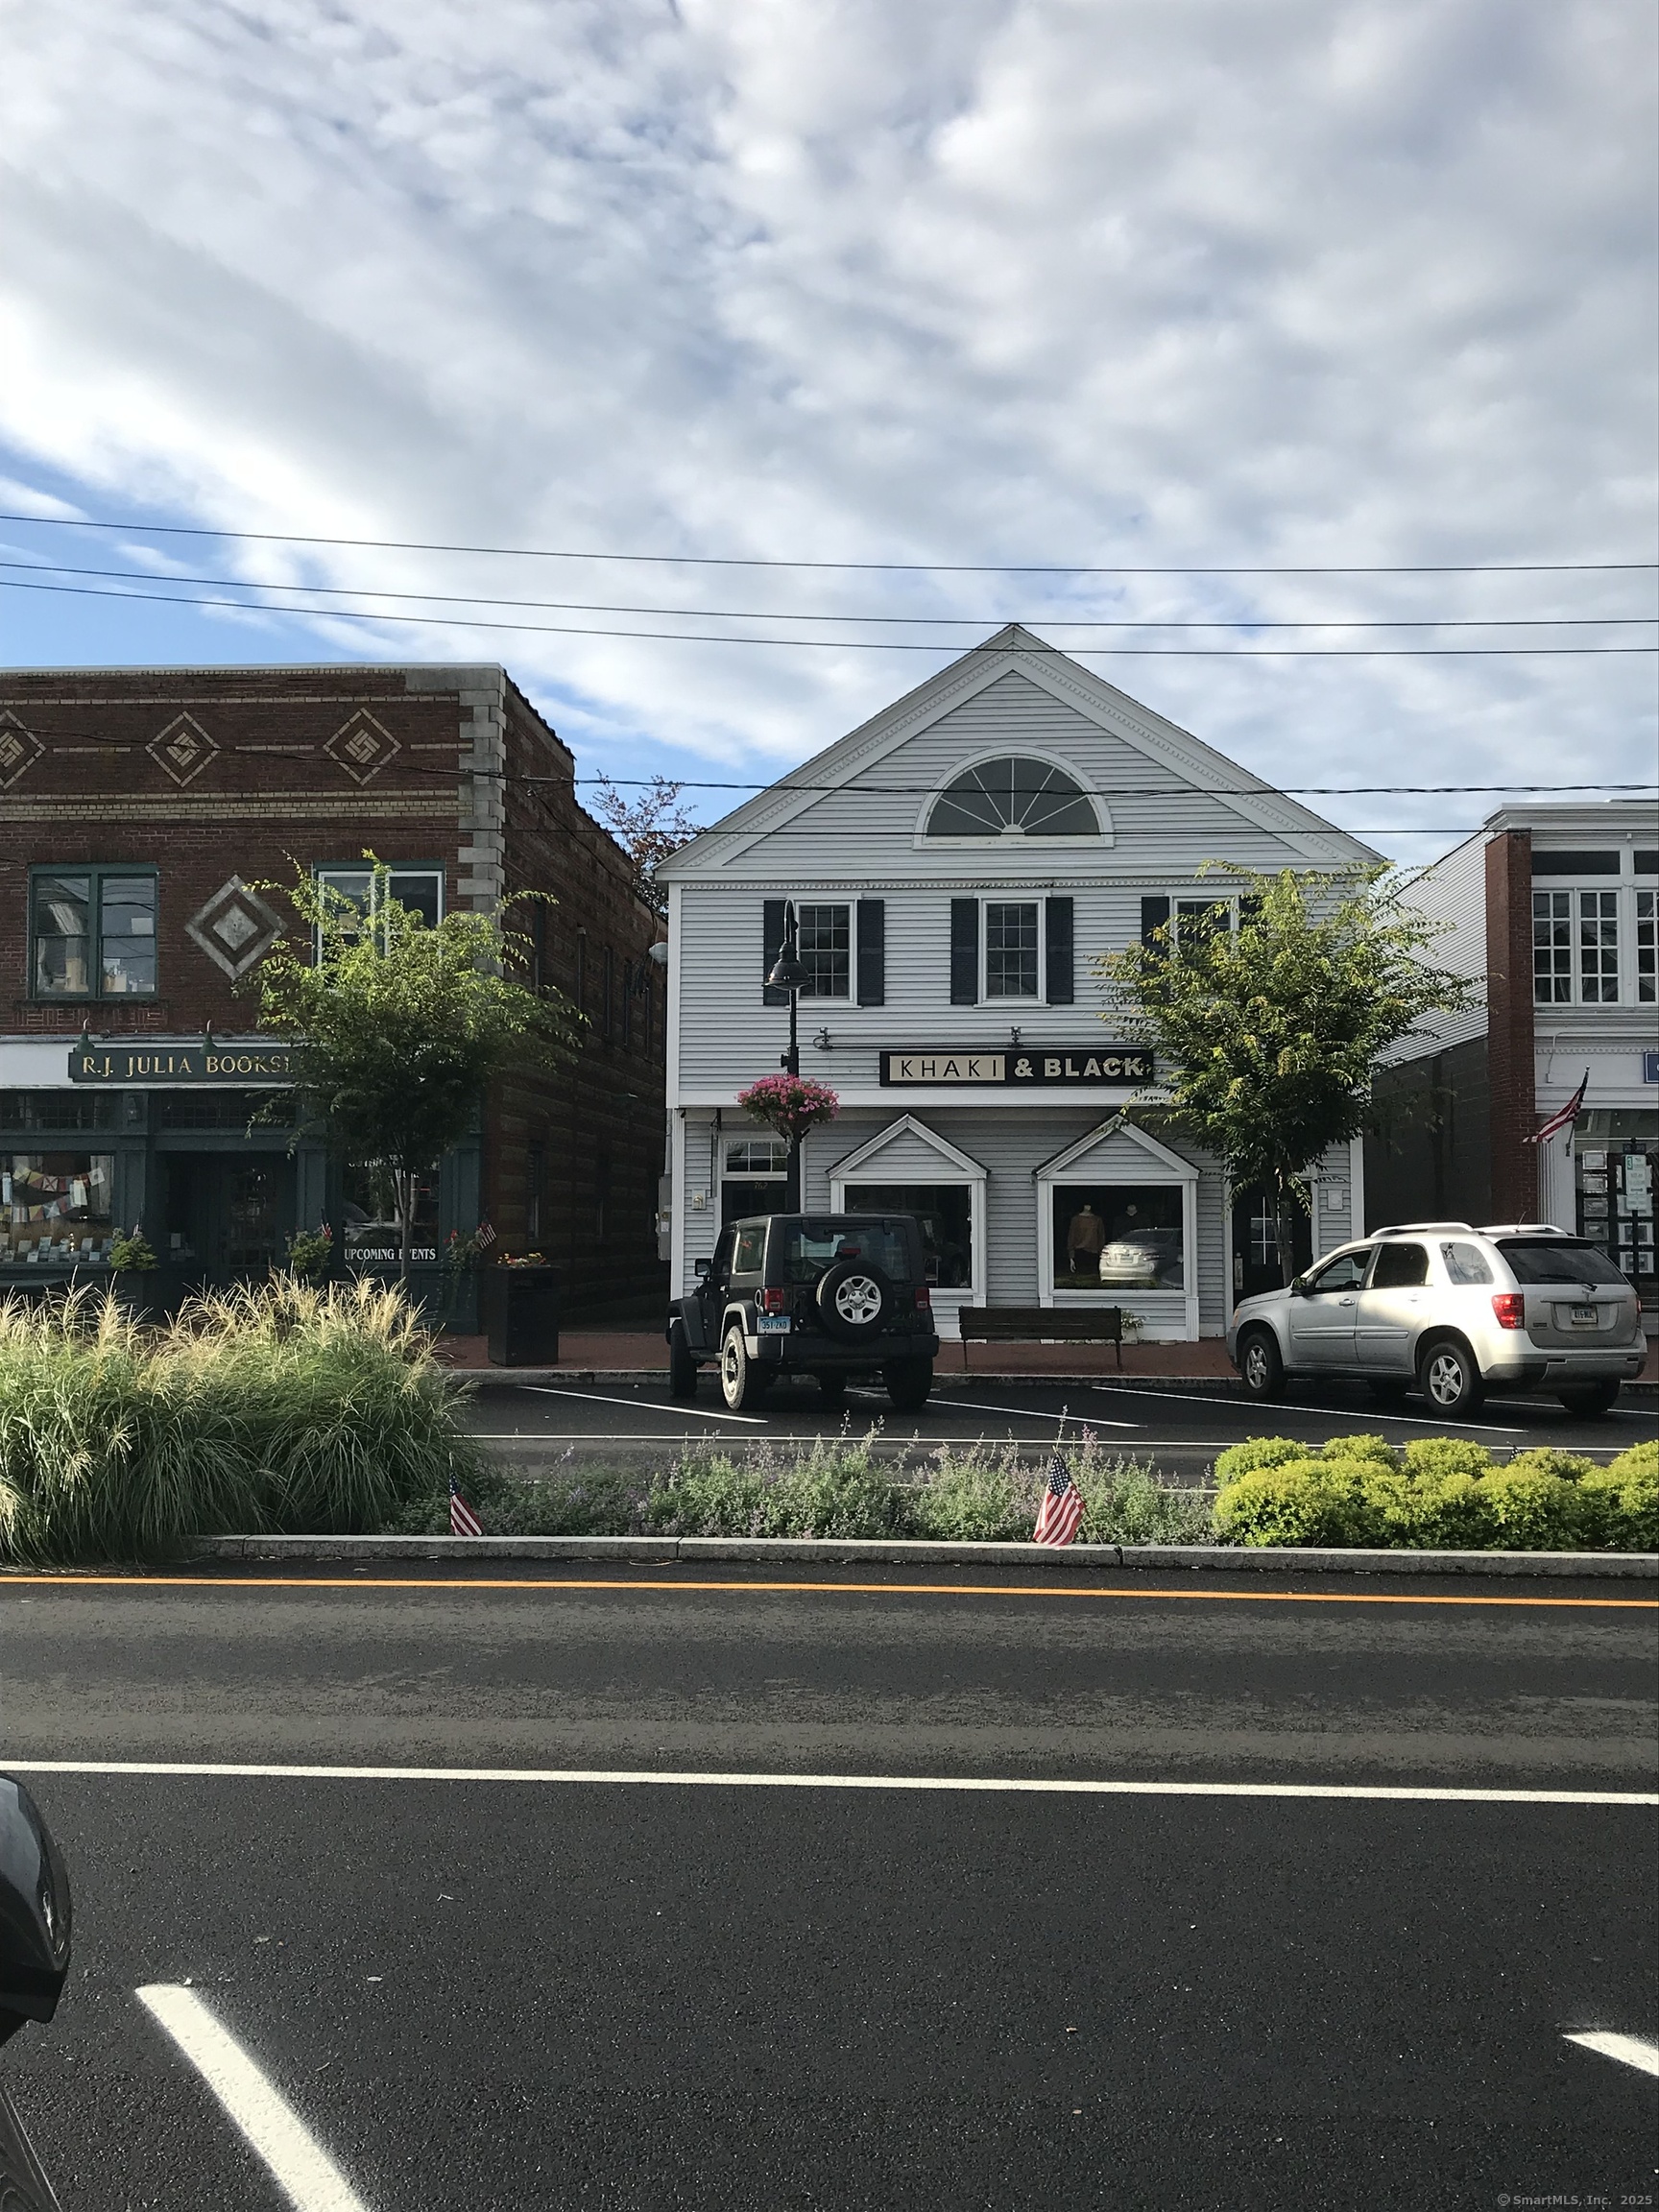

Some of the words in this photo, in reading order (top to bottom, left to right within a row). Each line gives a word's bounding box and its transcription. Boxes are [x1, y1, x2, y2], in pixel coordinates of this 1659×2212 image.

[83, 1056, 113, 1077] R.J.
[126, 1056, 192, 1077] JULIA
[900, 1059, 998, 1077] KHAKI
[1014, 1057, 1034, 1077] &
[1044, 1057, 1144, 1077] BLACK
[344, 1248, 395, 1261] UPCOMING
[398, 1248, 436, 1261] EENTS
